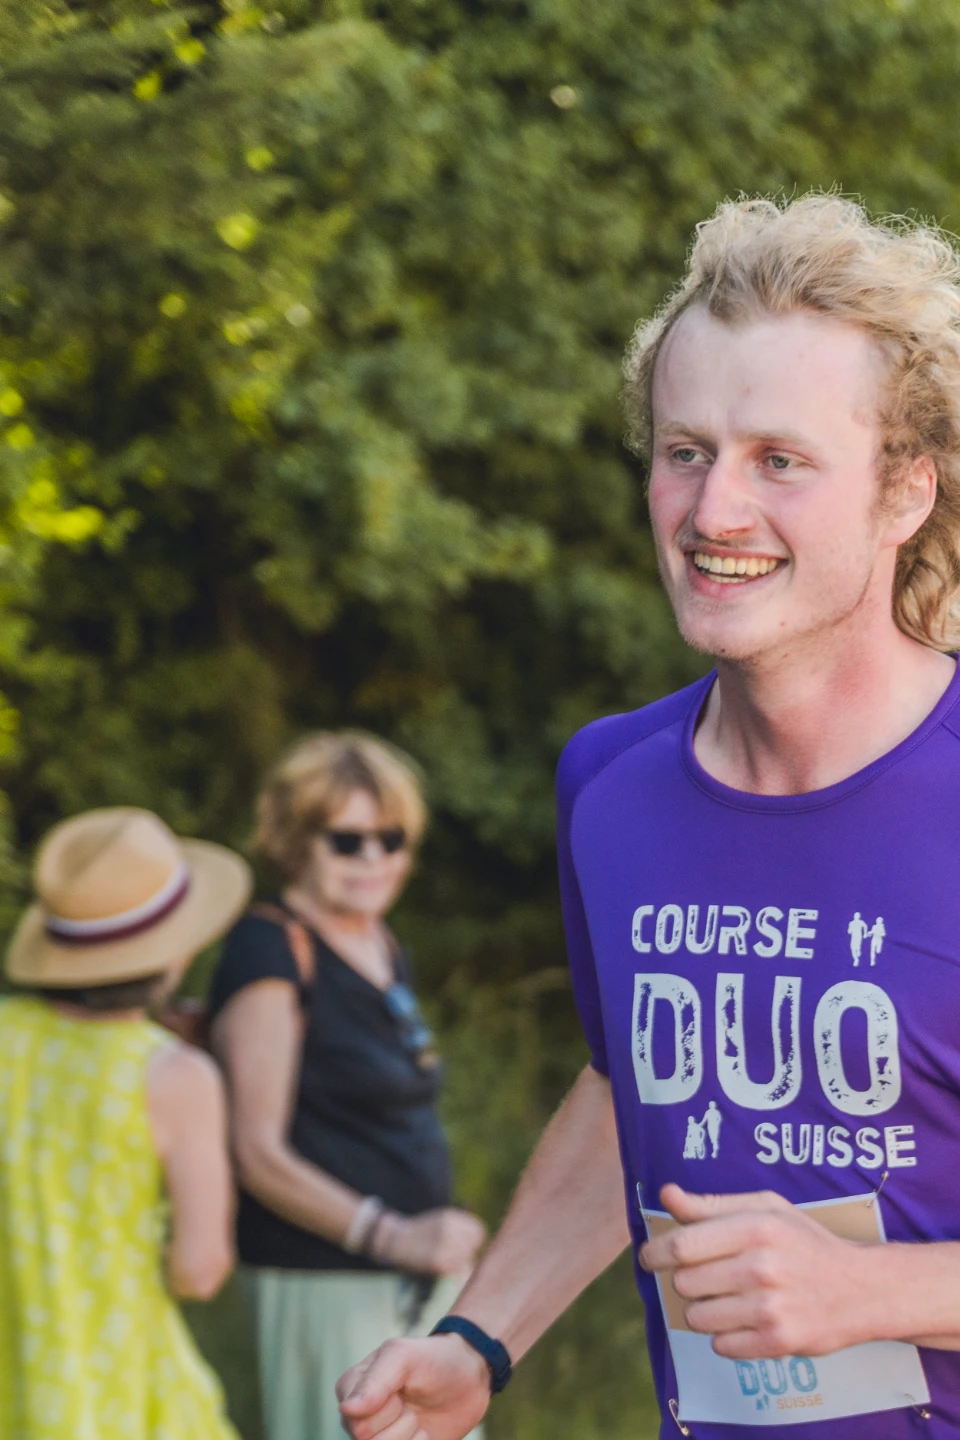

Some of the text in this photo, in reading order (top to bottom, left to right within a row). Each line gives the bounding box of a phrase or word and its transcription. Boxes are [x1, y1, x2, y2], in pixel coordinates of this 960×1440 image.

[631, 904, 819, 959] COURSE
[631, 972, 902, 1116] DUO
[754, 1122, 917, 1169] SUISSE
[736, 1357, 818, 1396] DUO
[776, 1394, 824, 1410] SUISSE
